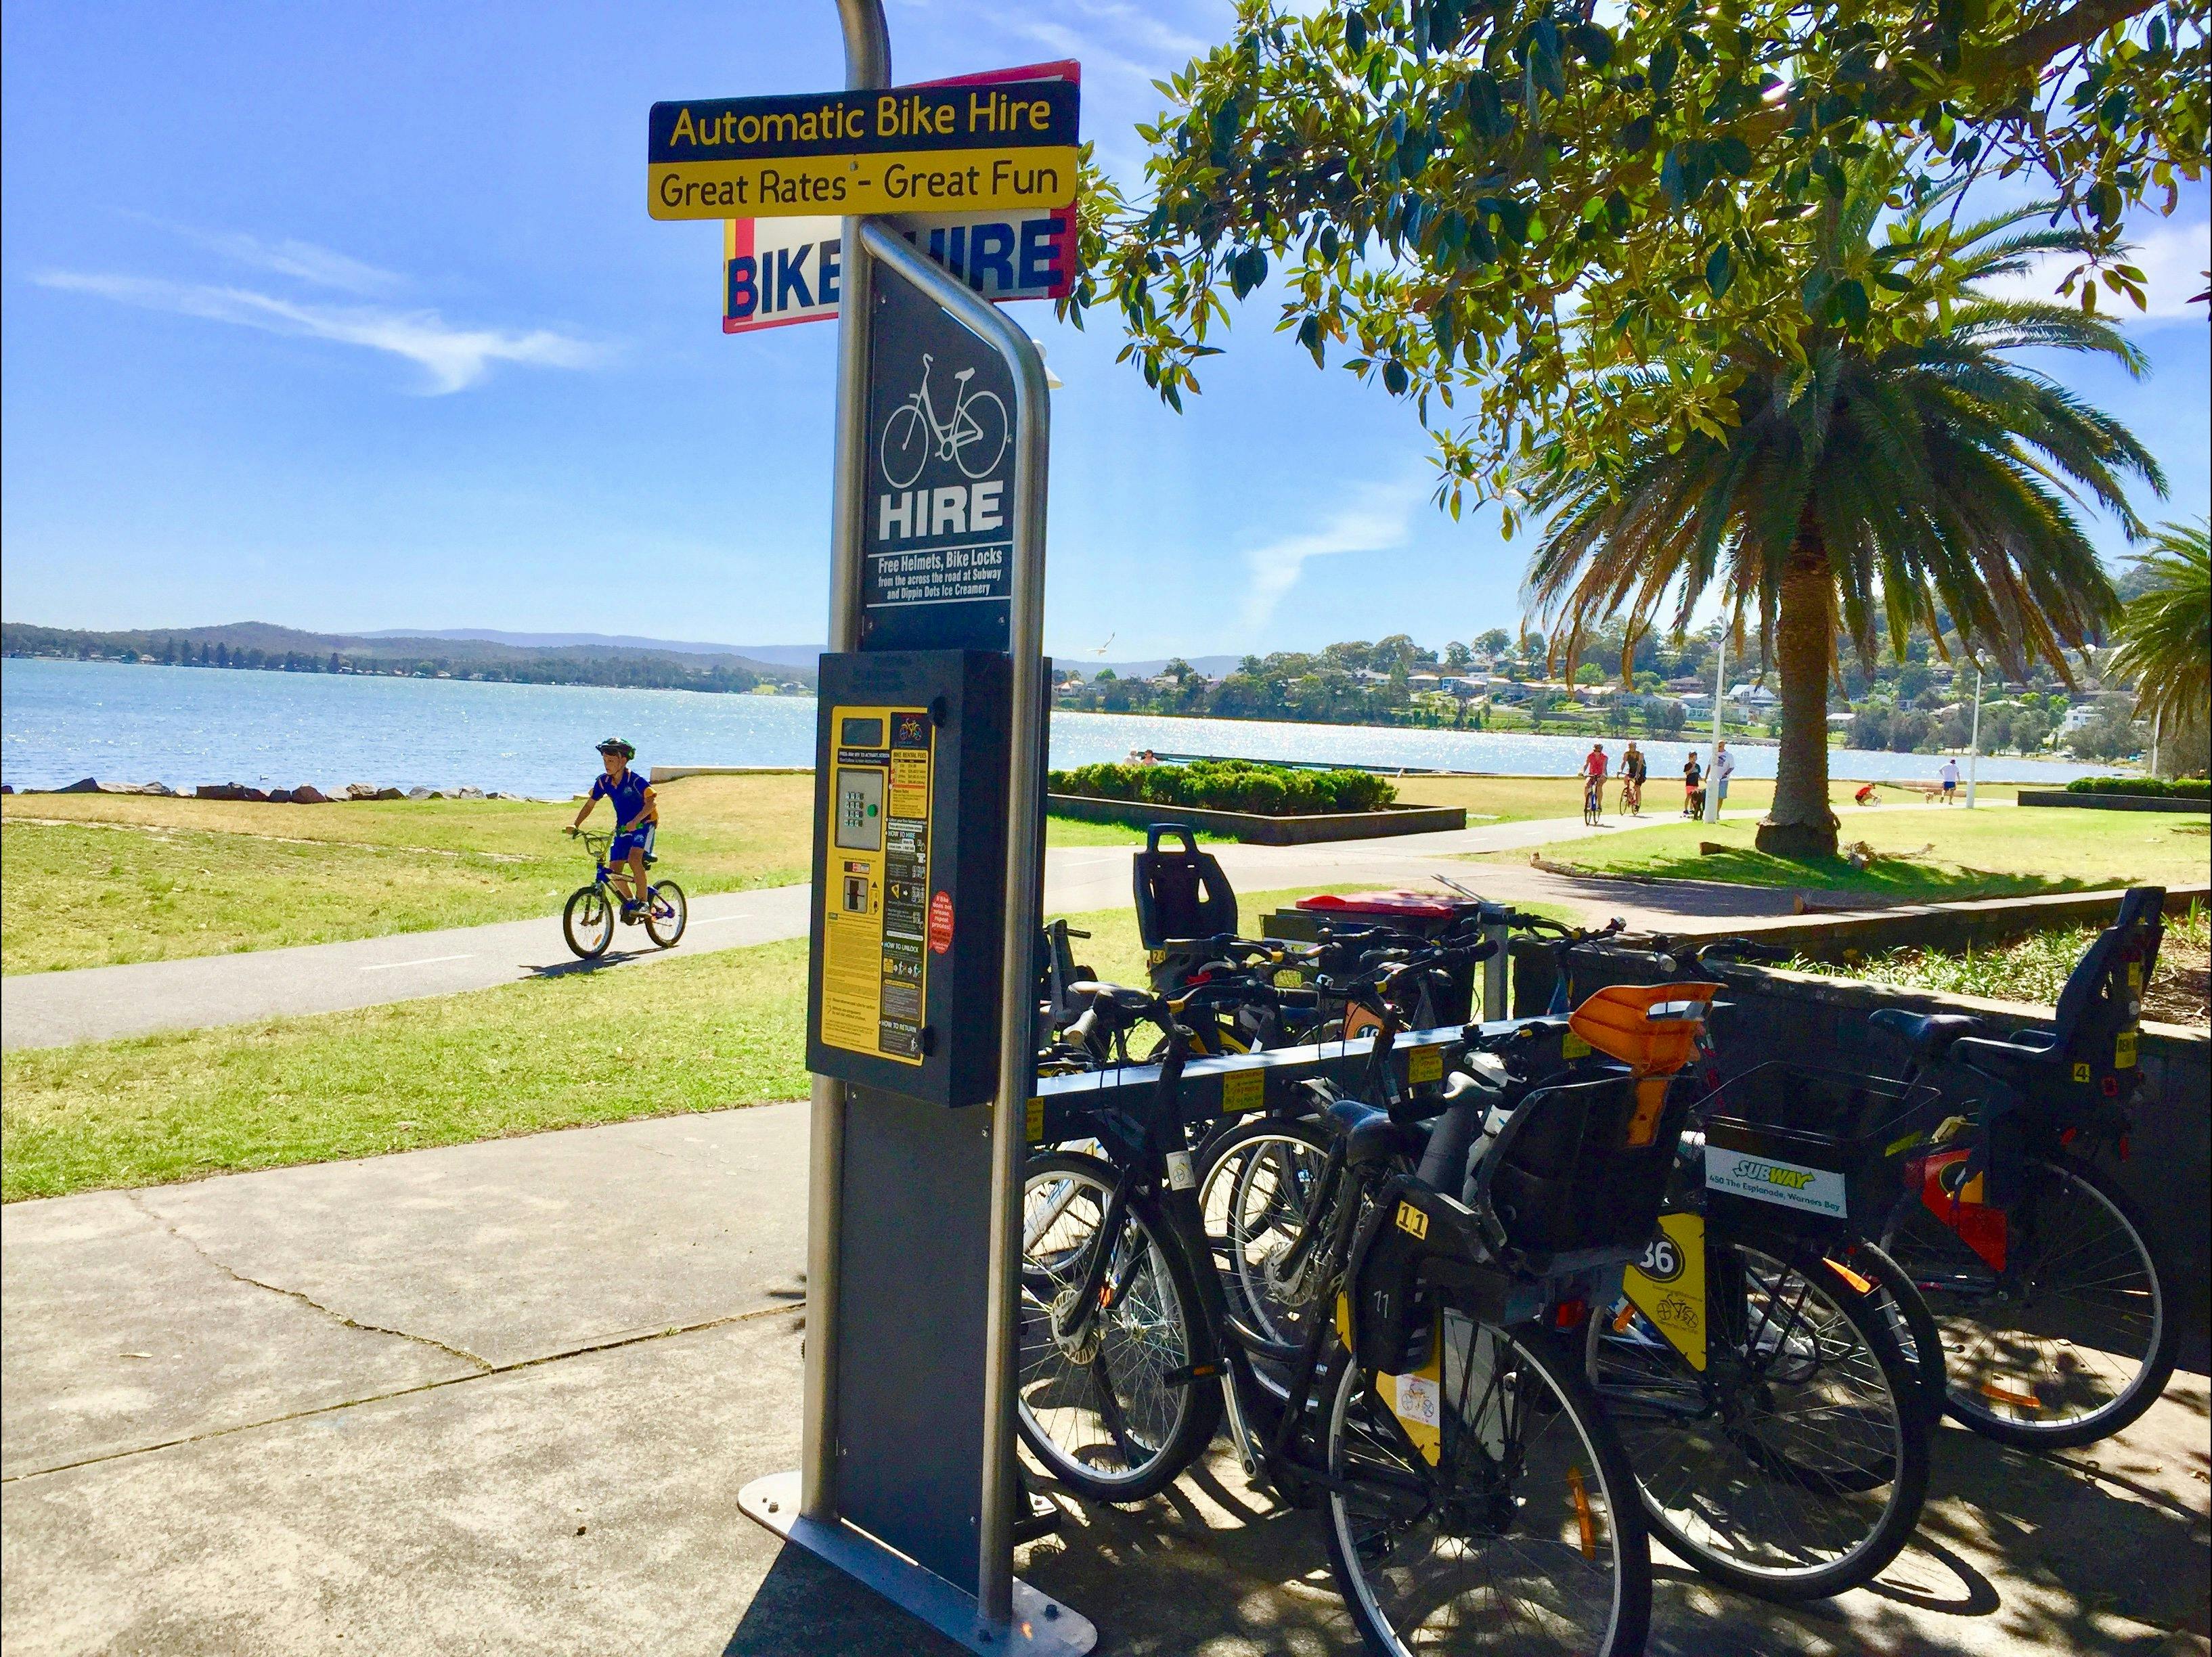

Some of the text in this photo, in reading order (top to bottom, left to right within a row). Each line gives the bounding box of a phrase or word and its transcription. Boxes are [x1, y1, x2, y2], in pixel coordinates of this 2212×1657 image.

[669, 91, 1050, 146] Automatic Bike Hire
[661, 173, 749, 207] Great
[759, 169, 846, 204] Rates
[884, 163, 980, 199] Great
[992, 160, 1058, 195] Fun
[728, 238, 841, 319] BIKE
[879, 480, 1004, 541] HIRE
[878, 548, 1002, 574] Free Helmets, Bike Locks
[878, 567, 1002, 588] from the across the road at Subway
[887, 583, 990, 600] and Dippin Dots Ice Creamery
[1733, 1159, 1815, 1190] SUBWAY
[1710, 1174, 1840, 1212] 450 The Esplanade, Warners Bay
[1398, 1206, 1424, 1237] 11
[1373, 1289, 1390, 1319] 11
